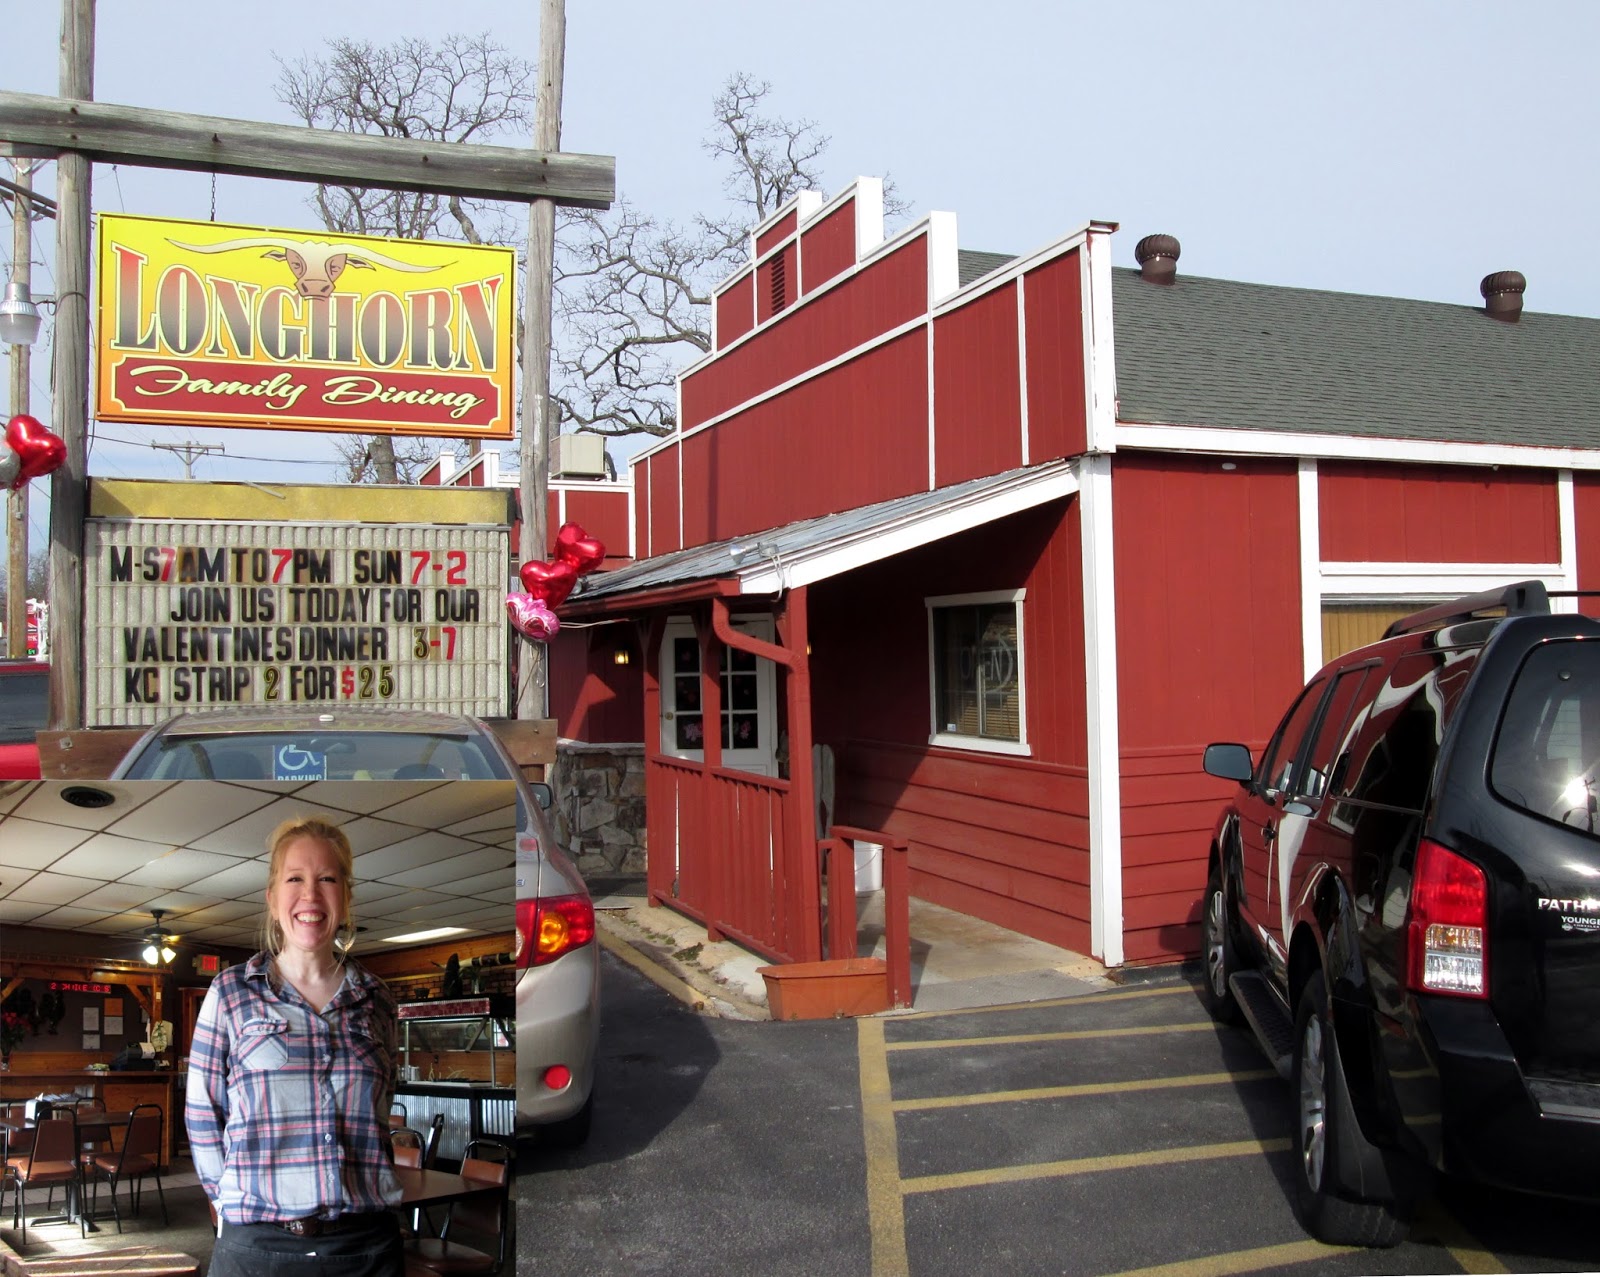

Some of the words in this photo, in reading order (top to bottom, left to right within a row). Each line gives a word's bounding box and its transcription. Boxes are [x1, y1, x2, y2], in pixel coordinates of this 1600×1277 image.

[111, 240, 504, 372] LONGHORN
[130, 365, 308, 410] Family
[321, 375, 485, 419] Dining
[355, 550, 402, 584] SUN
[170, 586, 231, 622] JOIN
[241, 587, 274, 622] US
[288, 587, 370, 622] TODAY
[379, 588, 422, 622] FOR
[435, 588, 480, 622] OUR
[124, 626, 292, 662] VALENTINES
[299, 626, 387, 661] DINNER
[413, 626, 457, 660] 3-7
[125, 666, 160, 703] KC
[174, 666, 250, 702] STRIP
[264, 665, 281, 701] 2
[290, 665, 336, 700] FOR
